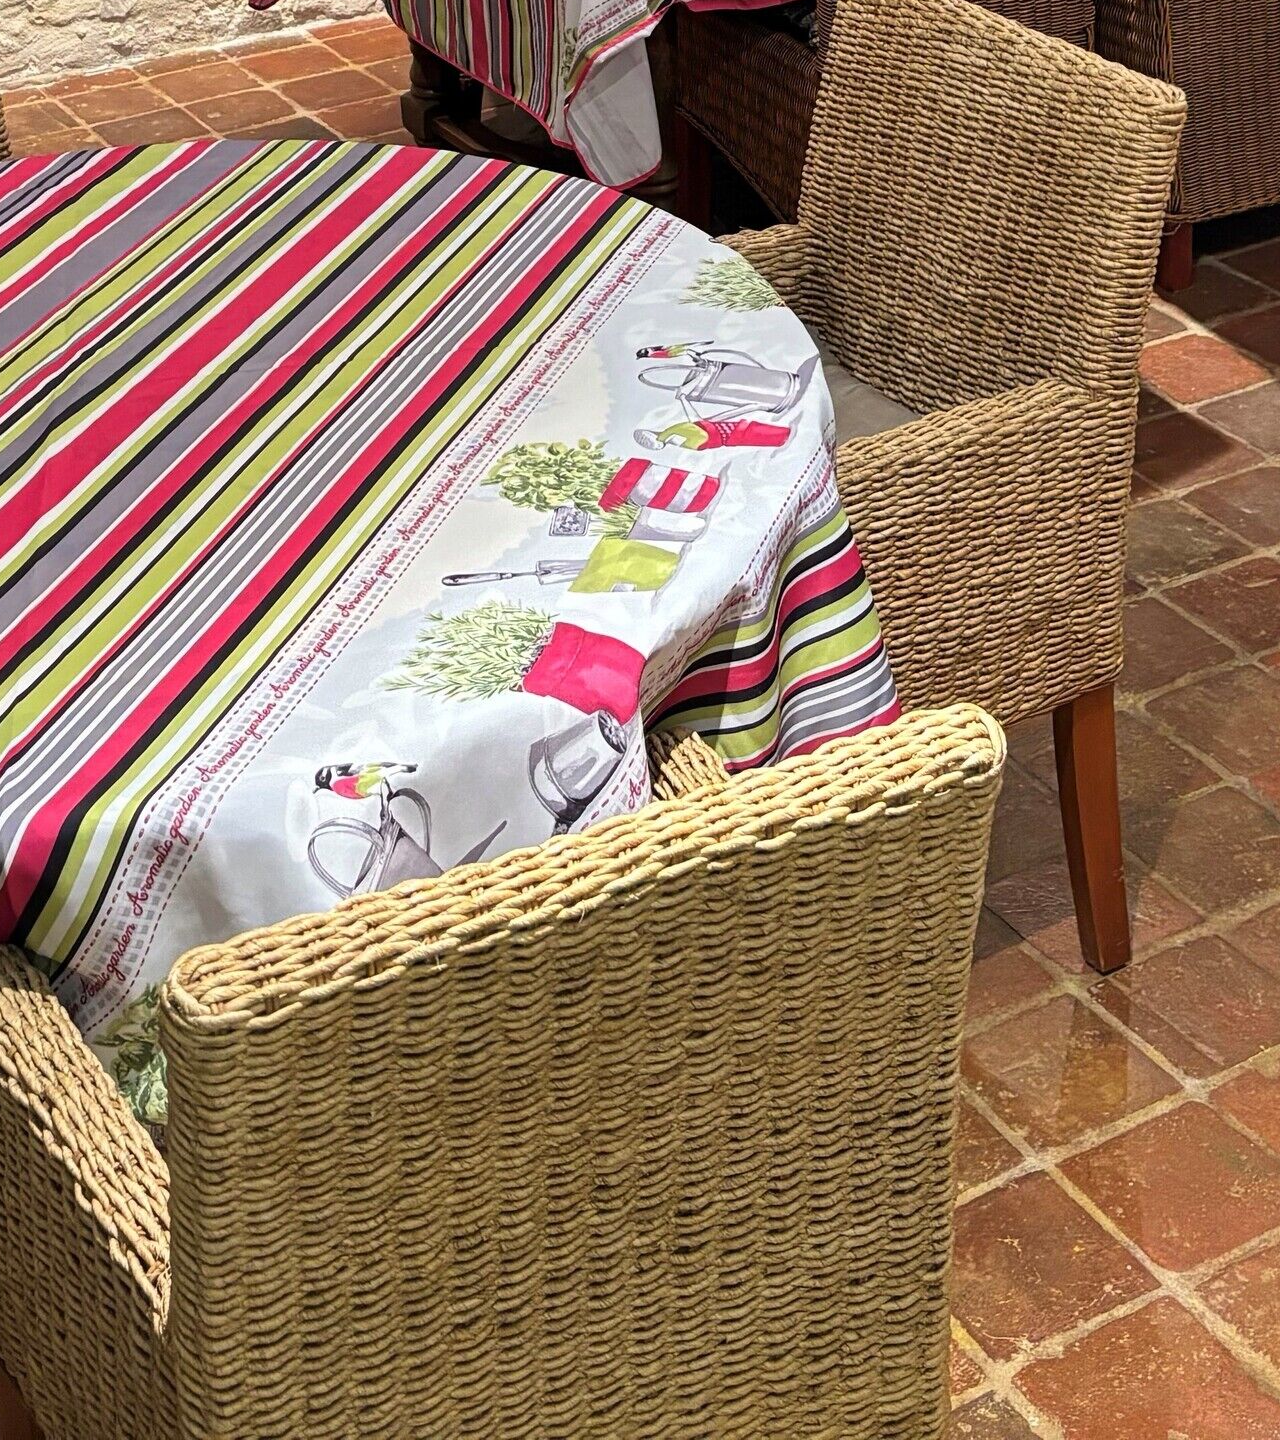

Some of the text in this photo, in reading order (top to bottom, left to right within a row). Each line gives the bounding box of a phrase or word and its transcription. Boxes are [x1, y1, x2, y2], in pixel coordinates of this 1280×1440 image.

[106, 923, 136, 981] garden
[126, 837, 174, 917] Aromatic
[169, 784, 203, 845] garden
[195, 735, 248, 783] Aromatic
[244, 702, 277, 740] garden
[269, 653, 317, 699] Aromatic
[313, 621, 343, 658] garden
[336, 576, 379, 618] Aromatic
[376, 546, 402, 579] garden
[397, 502, 436, 542] Aromatic
